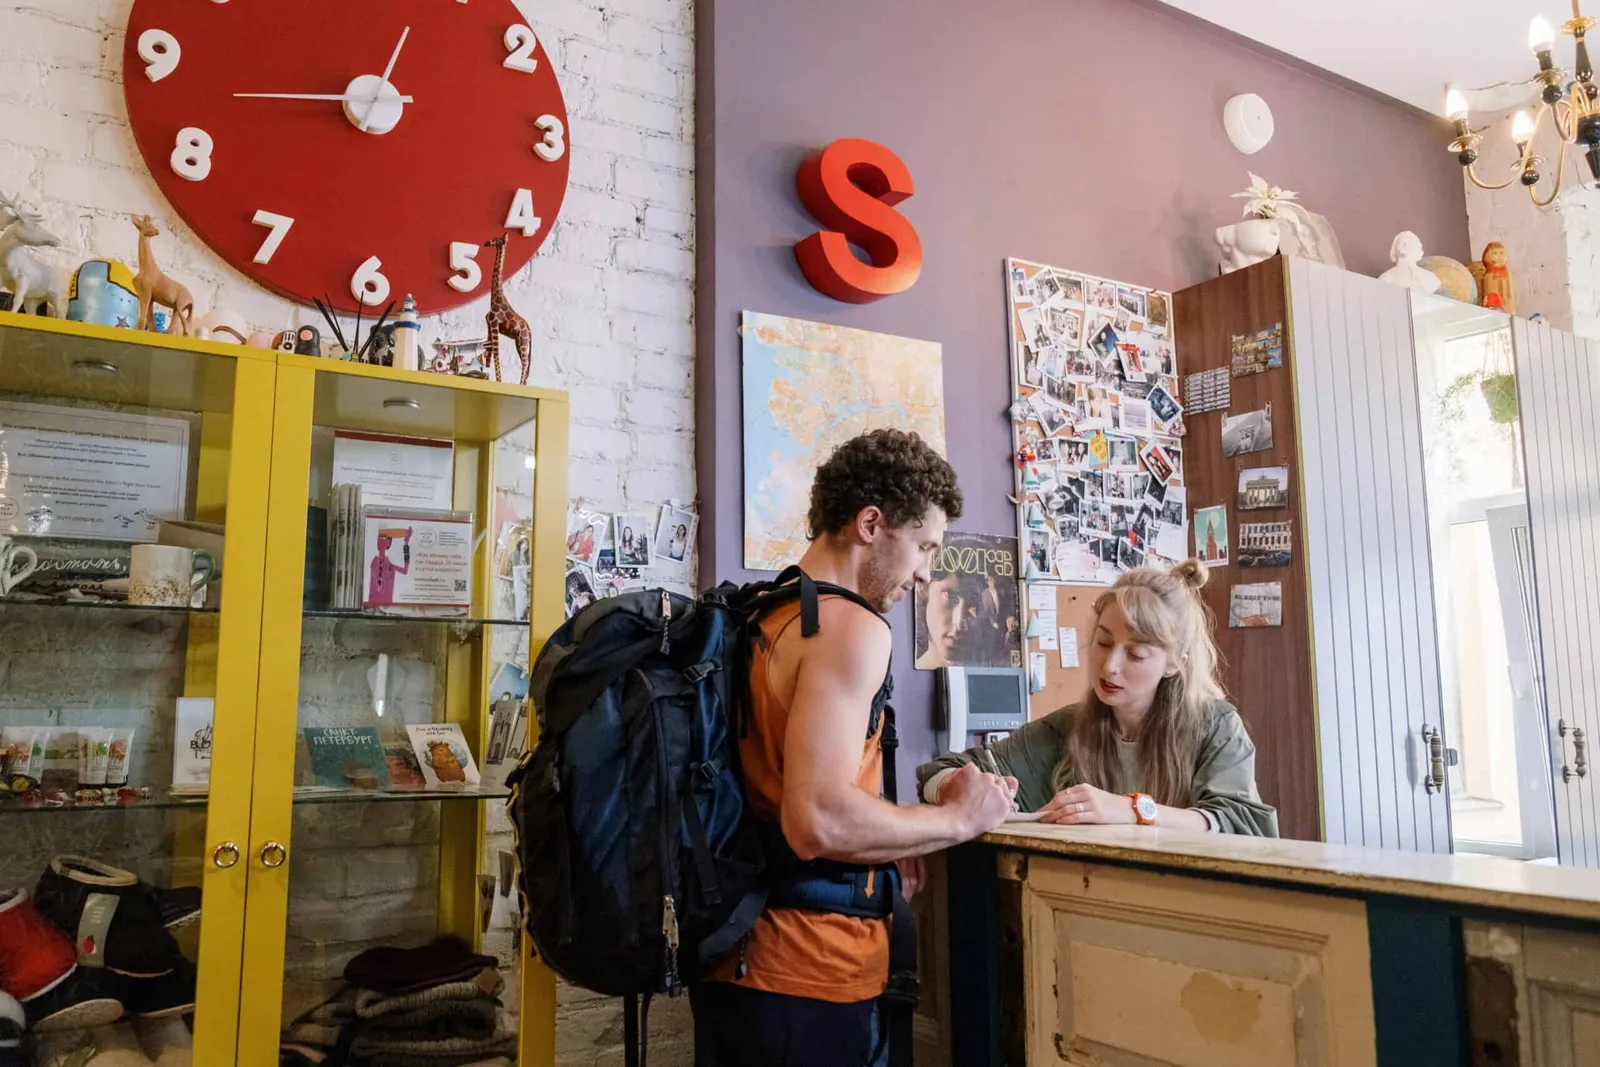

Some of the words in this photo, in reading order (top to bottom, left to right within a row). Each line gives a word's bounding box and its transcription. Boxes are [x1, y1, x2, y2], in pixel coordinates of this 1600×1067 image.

[138, 28, 181, 82] 9
[503, 24, 538, 74] 2
[170, 127, 214, 181] 8
[533, 114, 565, 162] 3
[252, 209, 295, 264] 7
[506, 188, 542, 237] 4
[794, 138, 922, 304] S
[351, 256, 390, 305] 6
[447, 242, 482, 292] 5
[313, 735, 373, 745] ПЕТЕРБУРГ
